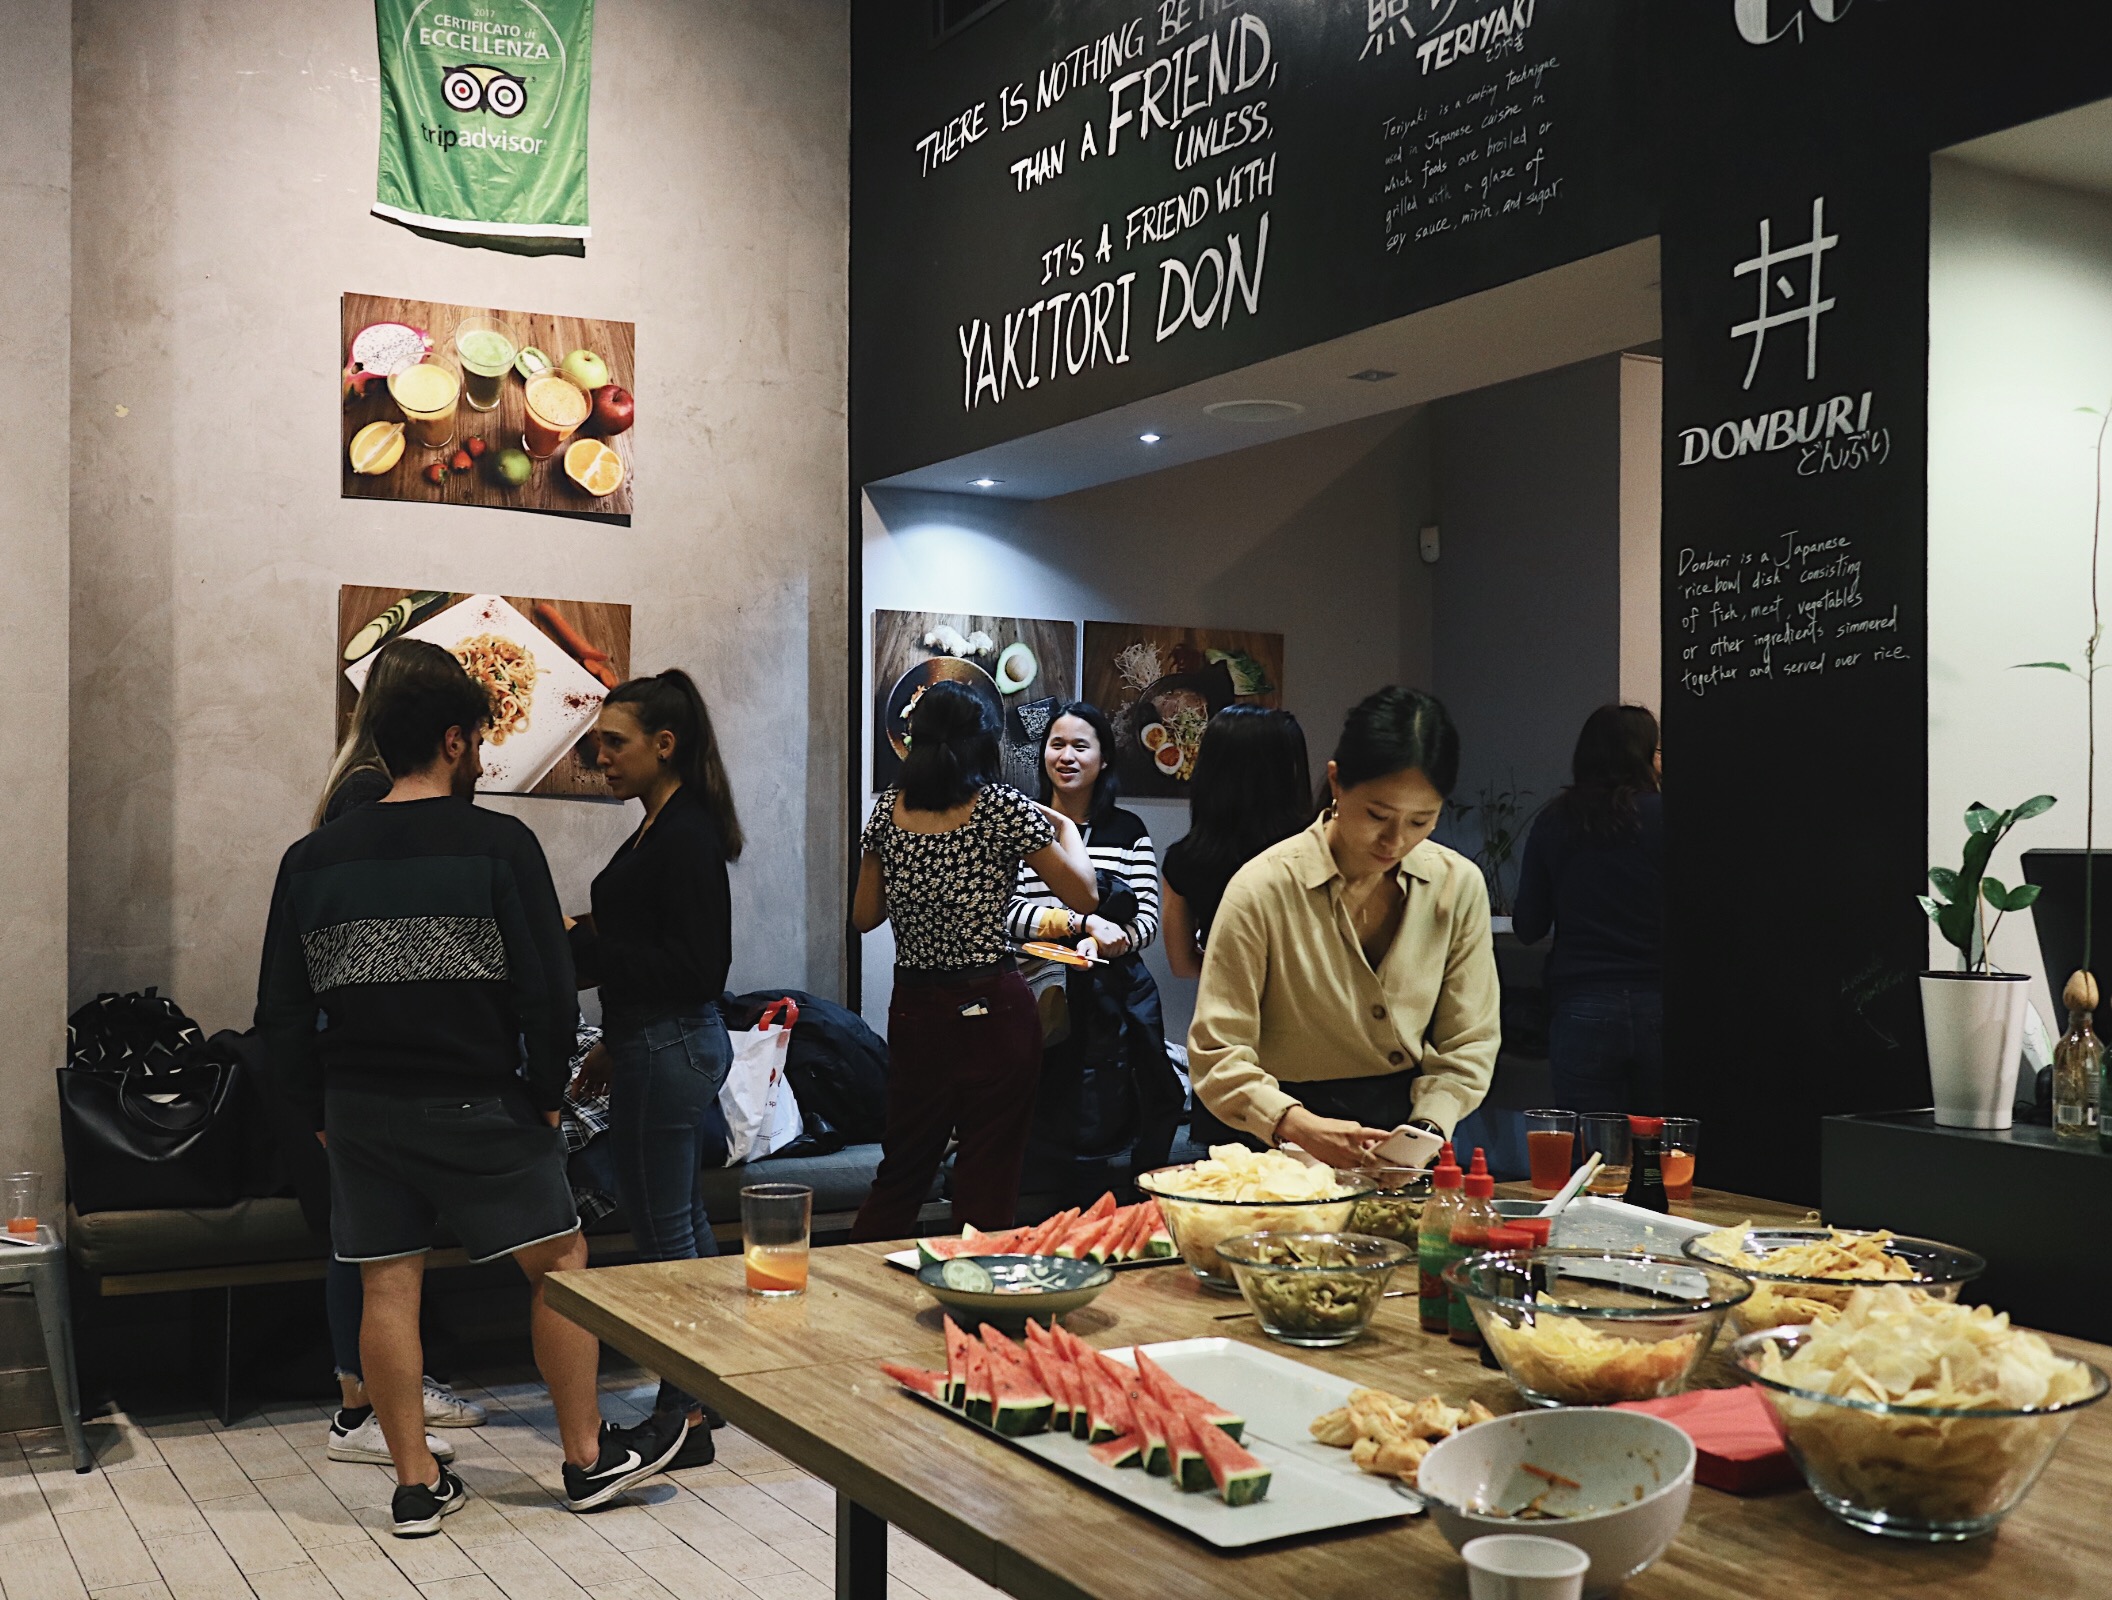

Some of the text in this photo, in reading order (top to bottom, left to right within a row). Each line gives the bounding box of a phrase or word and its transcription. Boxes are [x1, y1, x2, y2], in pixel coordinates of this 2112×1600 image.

[433, 13, 521, 37] CERTIFICATO
[473, 8, 496, 18] 2017
[1415, 0, 1536, 76] TERIYAKI
[419, 27, 551, 59] ECCELLENZA
[916, 102, 988, 178] THERE
[1000, 83, 1028, 132] IS
[1036, 17, 1144, 113] NOTHING
[1010, 12, 1280, 192] THAN A FRIEND,
[1383, 107, 1427, 140] Teriyaki
[1439, 104, 1449, 116] is
[1425, 125, 1473, 151] Japanese
[1531, 94, 1545, 107] in
[421, 122, 544, 154] tripadvisor
[1175, 101, 1274, 170] UNLESS,
[1421, 159, 1448, 189] foods
[1458, 149, 1479, 166] are
[1487, 125, 1527, 158] broiled
[1539, 121, 1553, 135] or
[1041, 152, 1277, 286] IT'S A FRIEND WITH
[1386, 194, 1418, 234] grilled
[1428, 183, 1452, 204] with
[1481, 167, 1515, 200] glaze
[1525, 147, 1545, 187] of
[1386, 232, 1407, 255] soy
[1502, 191, 1522, 213] and
[958, 210, 1270, 413] YAKITORI DON
[1678, 391, 1873, 467] DONBURI
[1796, 427, 1890, 476] どんぶり
[1678, 530, 1852, 577] Donburi is a Japanese
[1714, 569, 1741, 594] bowl
[1800, 553, 1861, 598] consisting
[1682, 607, 1700, 634] of
[1798, 586, 1863, 620] vegetables
[1683, 603, 1898, 664] or other ingredients simmered
[1681, 665, 1738, 697] together
[1749, 665, 1774, 680] and
[1782, 652, 1826, 676] served
[1835, 653, 1862, 668] over
